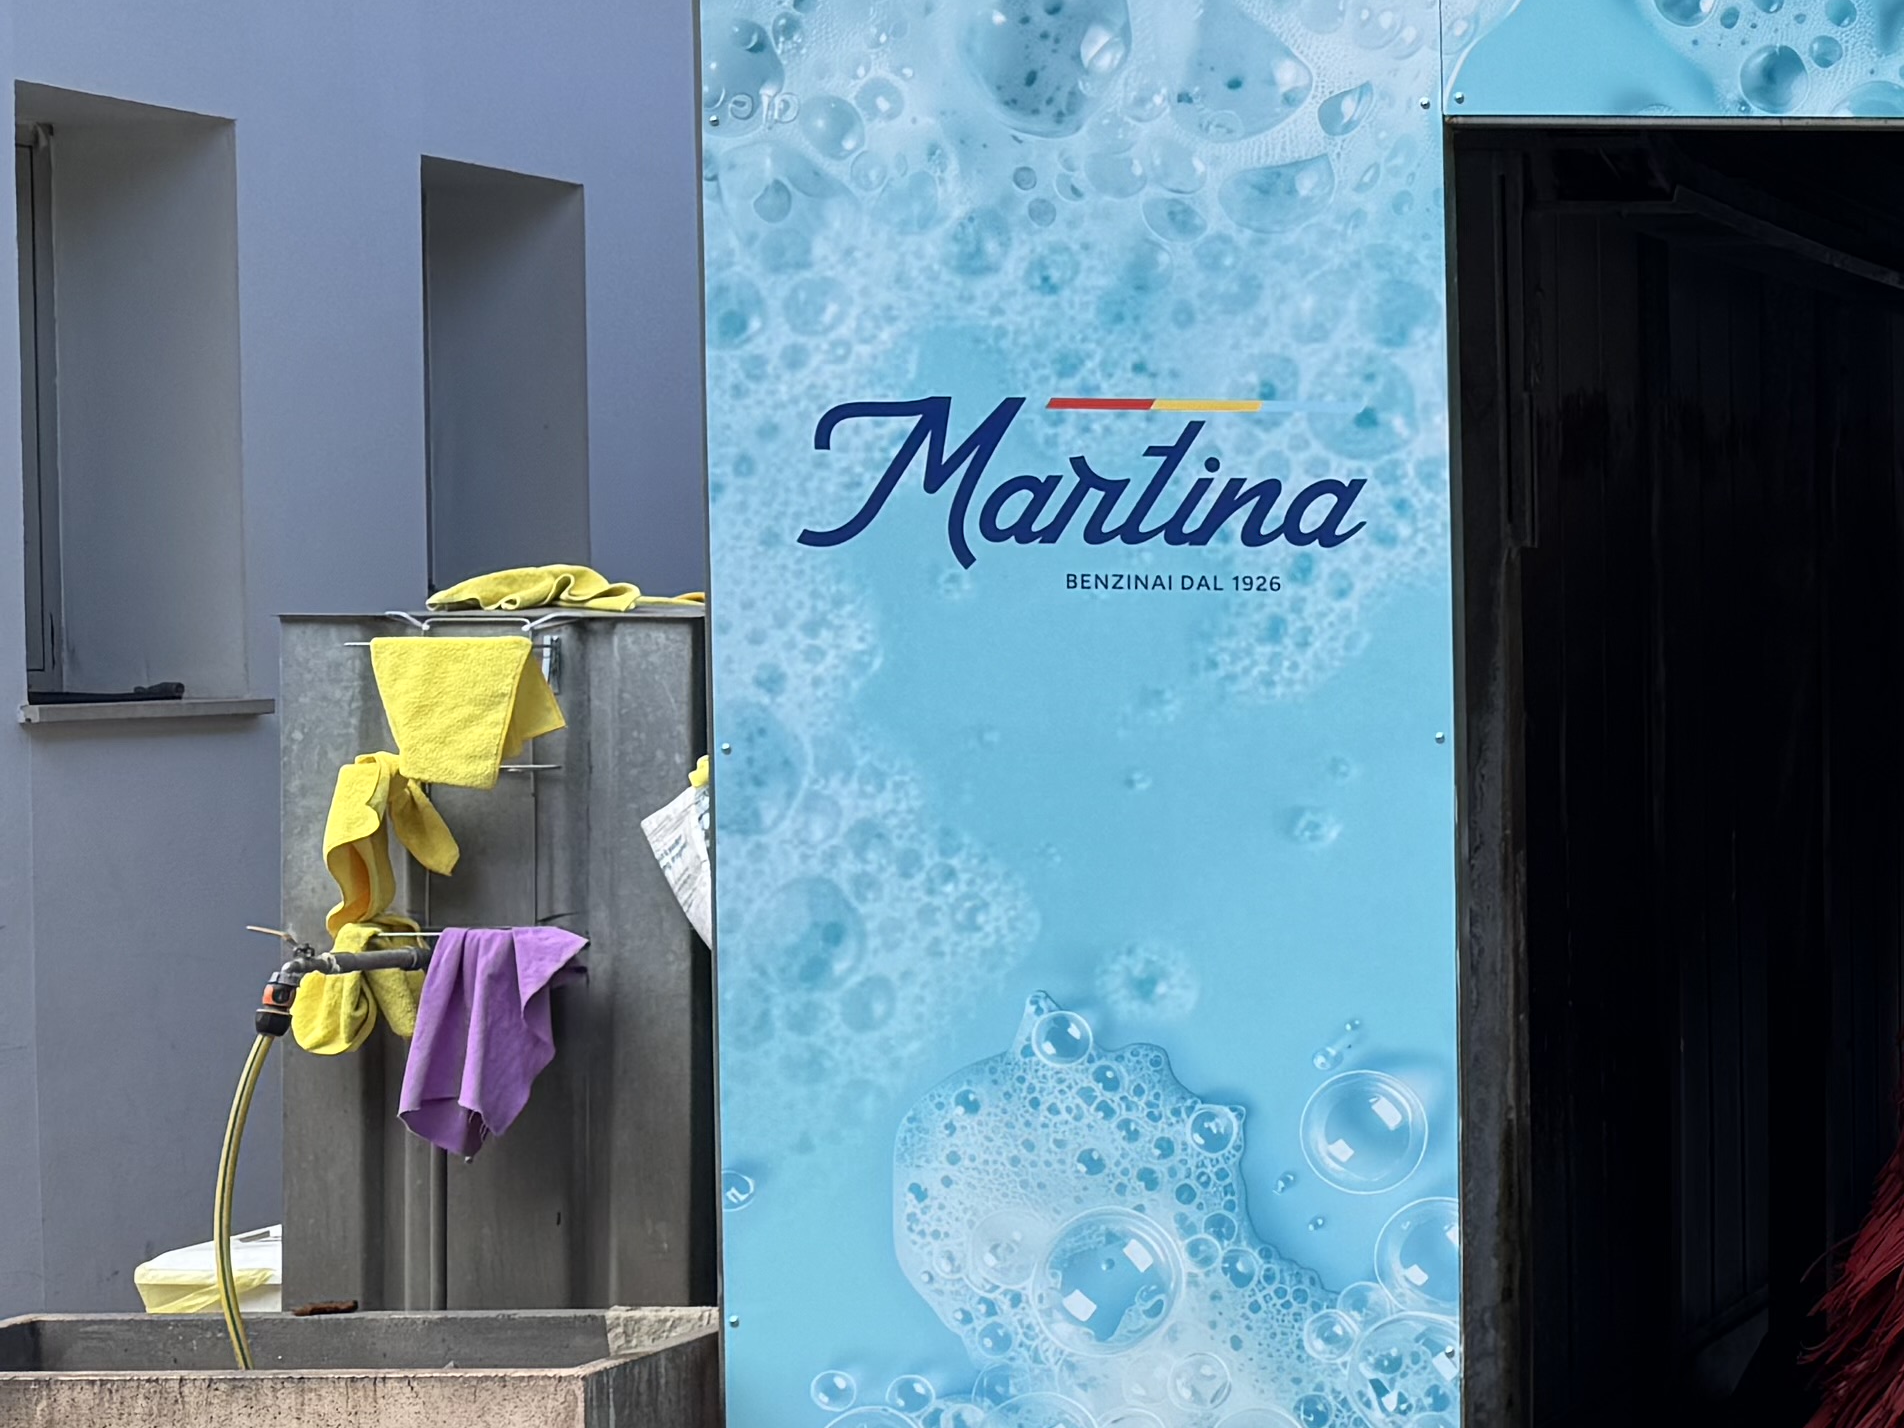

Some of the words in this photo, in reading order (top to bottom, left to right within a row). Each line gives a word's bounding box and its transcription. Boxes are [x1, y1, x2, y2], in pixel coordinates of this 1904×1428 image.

[797, 394, 1368, 569] Martina
[1066, 573, 1172, 590] BENZINAI
[1181, 575, 1223, 591] DAL
[1232, 575, 1281, 591] 1926
